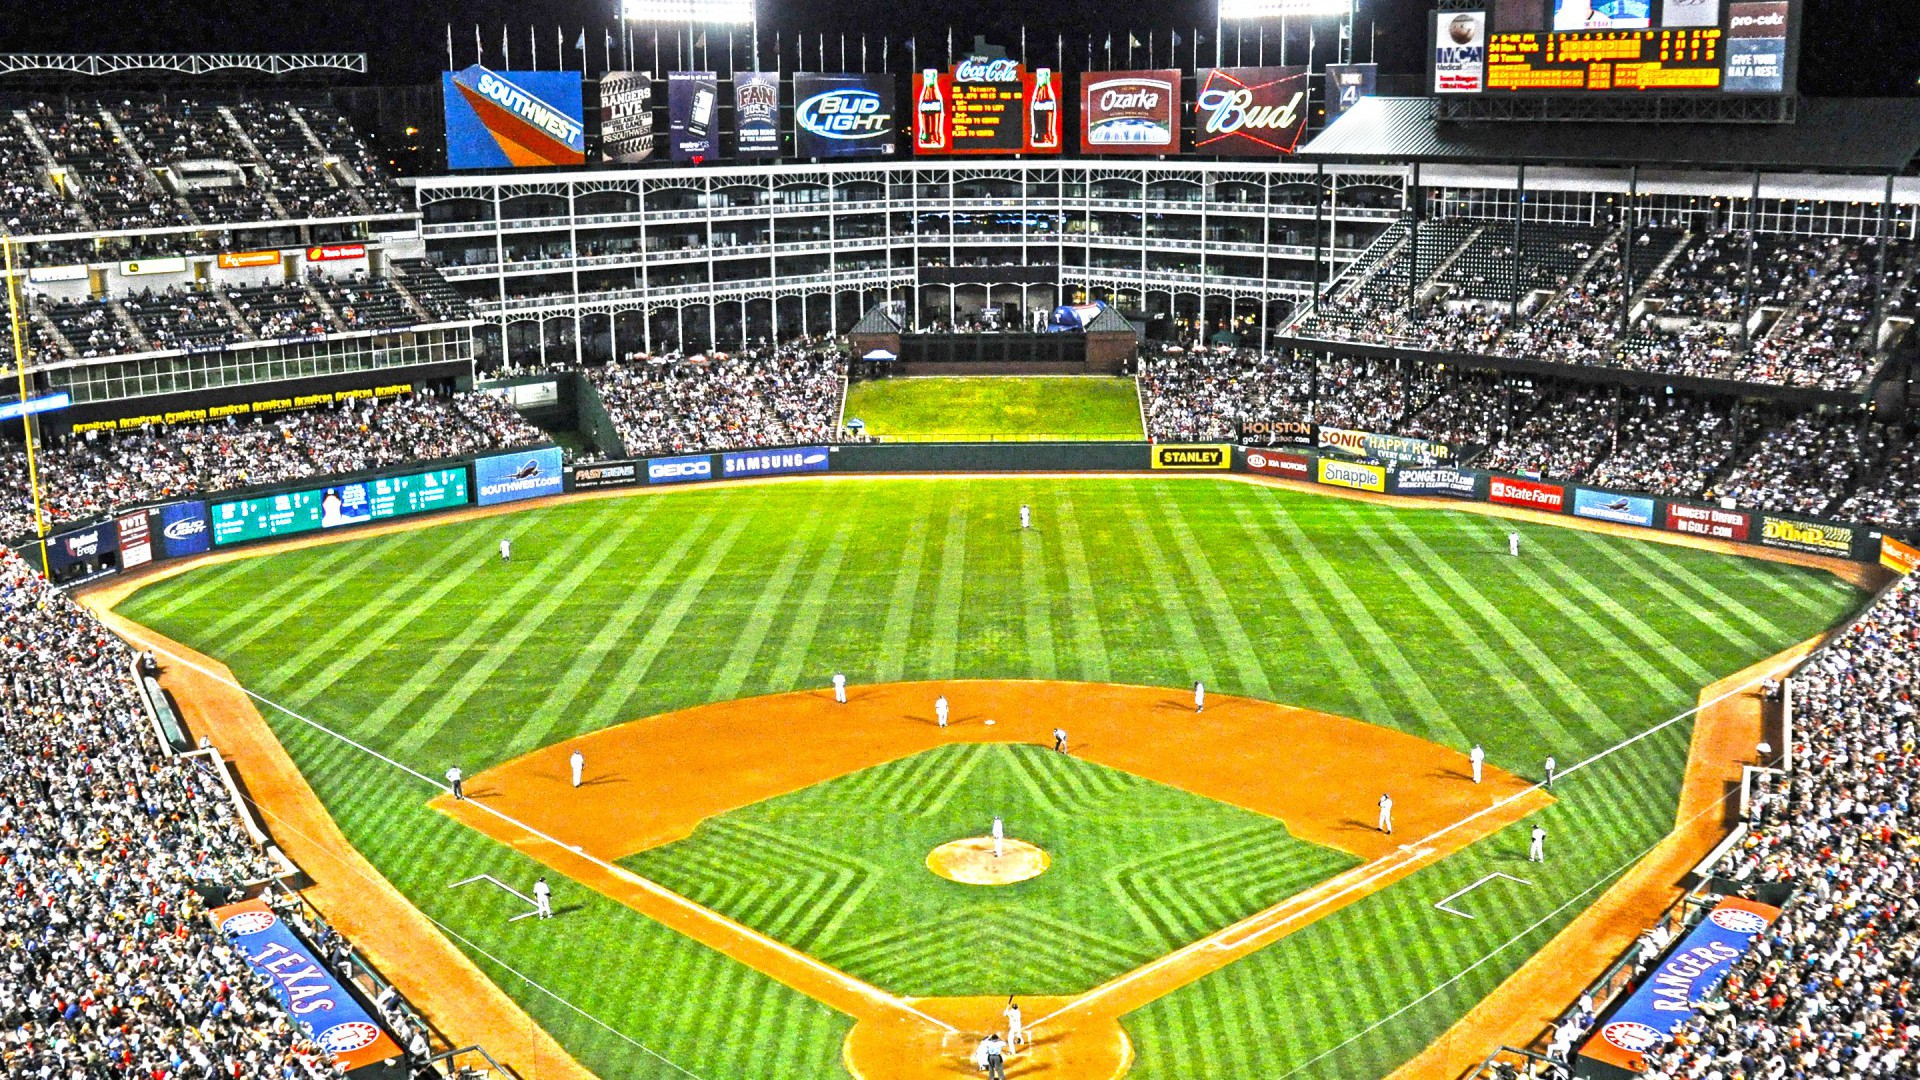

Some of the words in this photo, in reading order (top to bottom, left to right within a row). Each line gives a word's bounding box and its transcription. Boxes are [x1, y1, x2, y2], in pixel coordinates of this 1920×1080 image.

[1548, 33, 1554, 41] 1
[1645, 31, 1654, 40] 9
[1693, 30, 1700, 38] E
[1518, 43, 1539, 52] York
[1547, 42, 1554, 51] 2
[1661, 39, 1669, 49] 6
[1675, 39, 1686, 49] 11
[1501, 54, 1525, 62] Texas
[1732, 54, 1753, 65] GIVE
[1753, 54, 1777, 65] YOUR
[956, 59, 1019, 82] Coca-Cola
[1746, 66, 1754, 77] A
[601, 87, 651, 109] RANGERS
[740, 86, 774, 106] FAN
[1100, 88, 1159, 112] Ozarka
[1342, 85, 1358, 104] 4
[477, 73, 581, 144] SOUTHWEST
[611, 99, 643, 119] LIVE
[745, 103, 769, 115] 105.3
[817, 96, 880, 114] BUD
[1200, 89, 1304, 133] Bud
[612, 123, 624, 132] THE
[625, 120, 643, 129] GAME
[623, 115, 635, 123] AND
[635, 112, 652, 121] AFTER
[807, 113, 891, 131] LIGHT
[1242, 421, 1311, 435] HOUSTON
[1242, 434, 1310, 445] go2Hoston.com
[1320, 431, 1367, 448] SONIC
[1369, 437, 1409, 453] HAPPY
[725, 453, 803, 473] SAMSUNG
[1164, 451, 1219, 463] STANLEY
[1398, 452, 1413, 461] DAY
[575, 465, 635, 480] FASTSIGNS
[649, 461, 711, 478] GEICO
[1325, 463, 1378, 487] Snapple
[1398, 470, 1475, 486] SPONGETECH.com
[480, 476, 561, 496] SOUTHWEST.COM
[1503, 485, 1531, 500] State
[1533, 489, 1562, 505] Farm
[119, 513, 147, 531] VOTE
[1671, 504, 1711, 520] LONGEST
[1711, 510, 1743, 526] DRIVER
[171, 525, 207, 536] LIGHT
[175, 519, 205, 530] BUD
[77, 543, 98, 557] Energy
[249, 941, 336, 1015] TEXAS
[1652, 941, 1740, 1012] RANGERS
